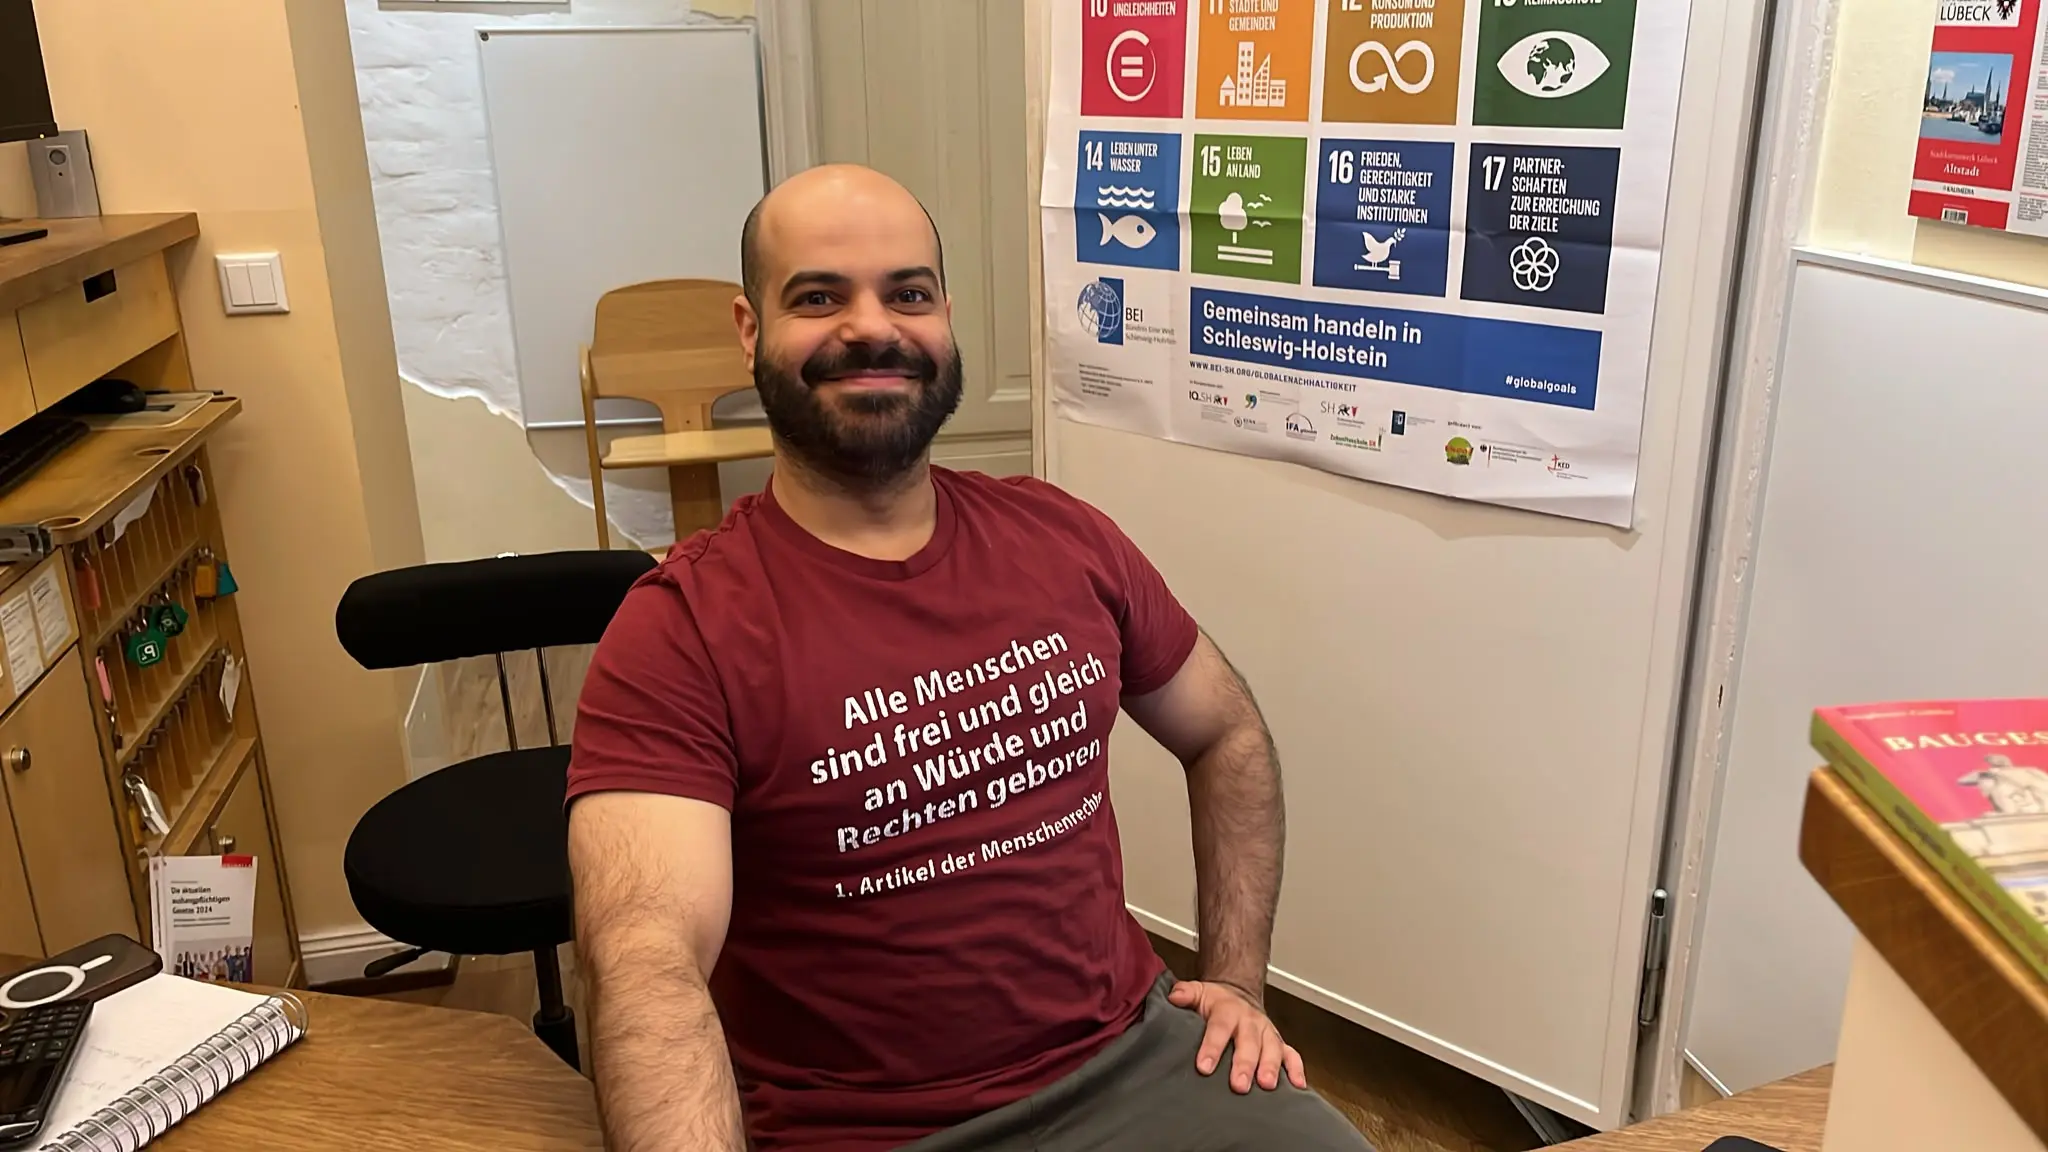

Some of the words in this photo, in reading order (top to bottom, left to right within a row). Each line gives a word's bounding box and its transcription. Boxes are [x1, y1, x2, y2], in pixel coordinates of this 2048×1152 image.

[1113, 1, 1176, 17] UNGLEICHHEITEN
[1940, 2, 1992, 21] LÜBECK
[1229, 16, 1276, 31] GEMEINDEN
[1370, 12, 1434, 29] PRODUKTION
[1084, 140, 1103, 171] 14
[1110, 141, 1133, 156] LEBEN
[1134, 143, 1158, 157] UNTER
[1227, 146, 1252, 161] LEBEN
[1110, 158, 1141, 173] WASSER
[1200, 145, 1221, 177] 15
[1329, 150, 1354, 184] 16
[1360, 151, 1402, 169] FRIEDEN,
[1513, 157, 1565, 175] PARTNER-
[1226, 163, 1239, 178] AN
[1239, 164, 1261, 179] LAND
[1359, 171, 1433, 188] GERECHTIGKEIT
[1482, 155, 1506, 191] 17
[1943, 163, 1980, 177] Altstadt
[1512, 176, 1567, 195] SCHAFTEN
[1359, 187, 1379, 203] UND
[1380, 189, 1416, 206] STARKE
[1511, 195, 1532, 212] ZUR
[1532, 197, 1601, 217] ERREICHUNG
[1357, 205, 1428, 225] INSTITUTIONEN
[1510, 214, 1529, 231] DER
[1531, 216, 1559, 233] ZIELE
[1125, 307, 1143, 322] BEI
[1203, 299, 1309, 332] Gemeinsam
[1314, 313, 1397, 342] handeln
[1402, 321, 1422, 345] in
[1202, 325, 1388, 368] Schleswig-Holstein
[1505, 375, 1577, 394] #globalgoals
[844, 687, 909, 729] Alle
[913, 631, 1068, 706] Menschen
[810, 733, 887, 785] sind
[894, 710, 951, 758] frei
[958, 684, 1022, 733] und
[1029, 652, 1106, 714] gleich
[864, 778, 908, 811] an
[913, 732, 1024, 792] Würde
[1030, 700, 1087, 749] und
[837, 788, 977, 853] Rechten
[986, 738, 1101, 809] geboren
[835, 882, 853, 898] 1.
[860, 859, 935, 896] Artikel
[941, 851, 975, 876] der
